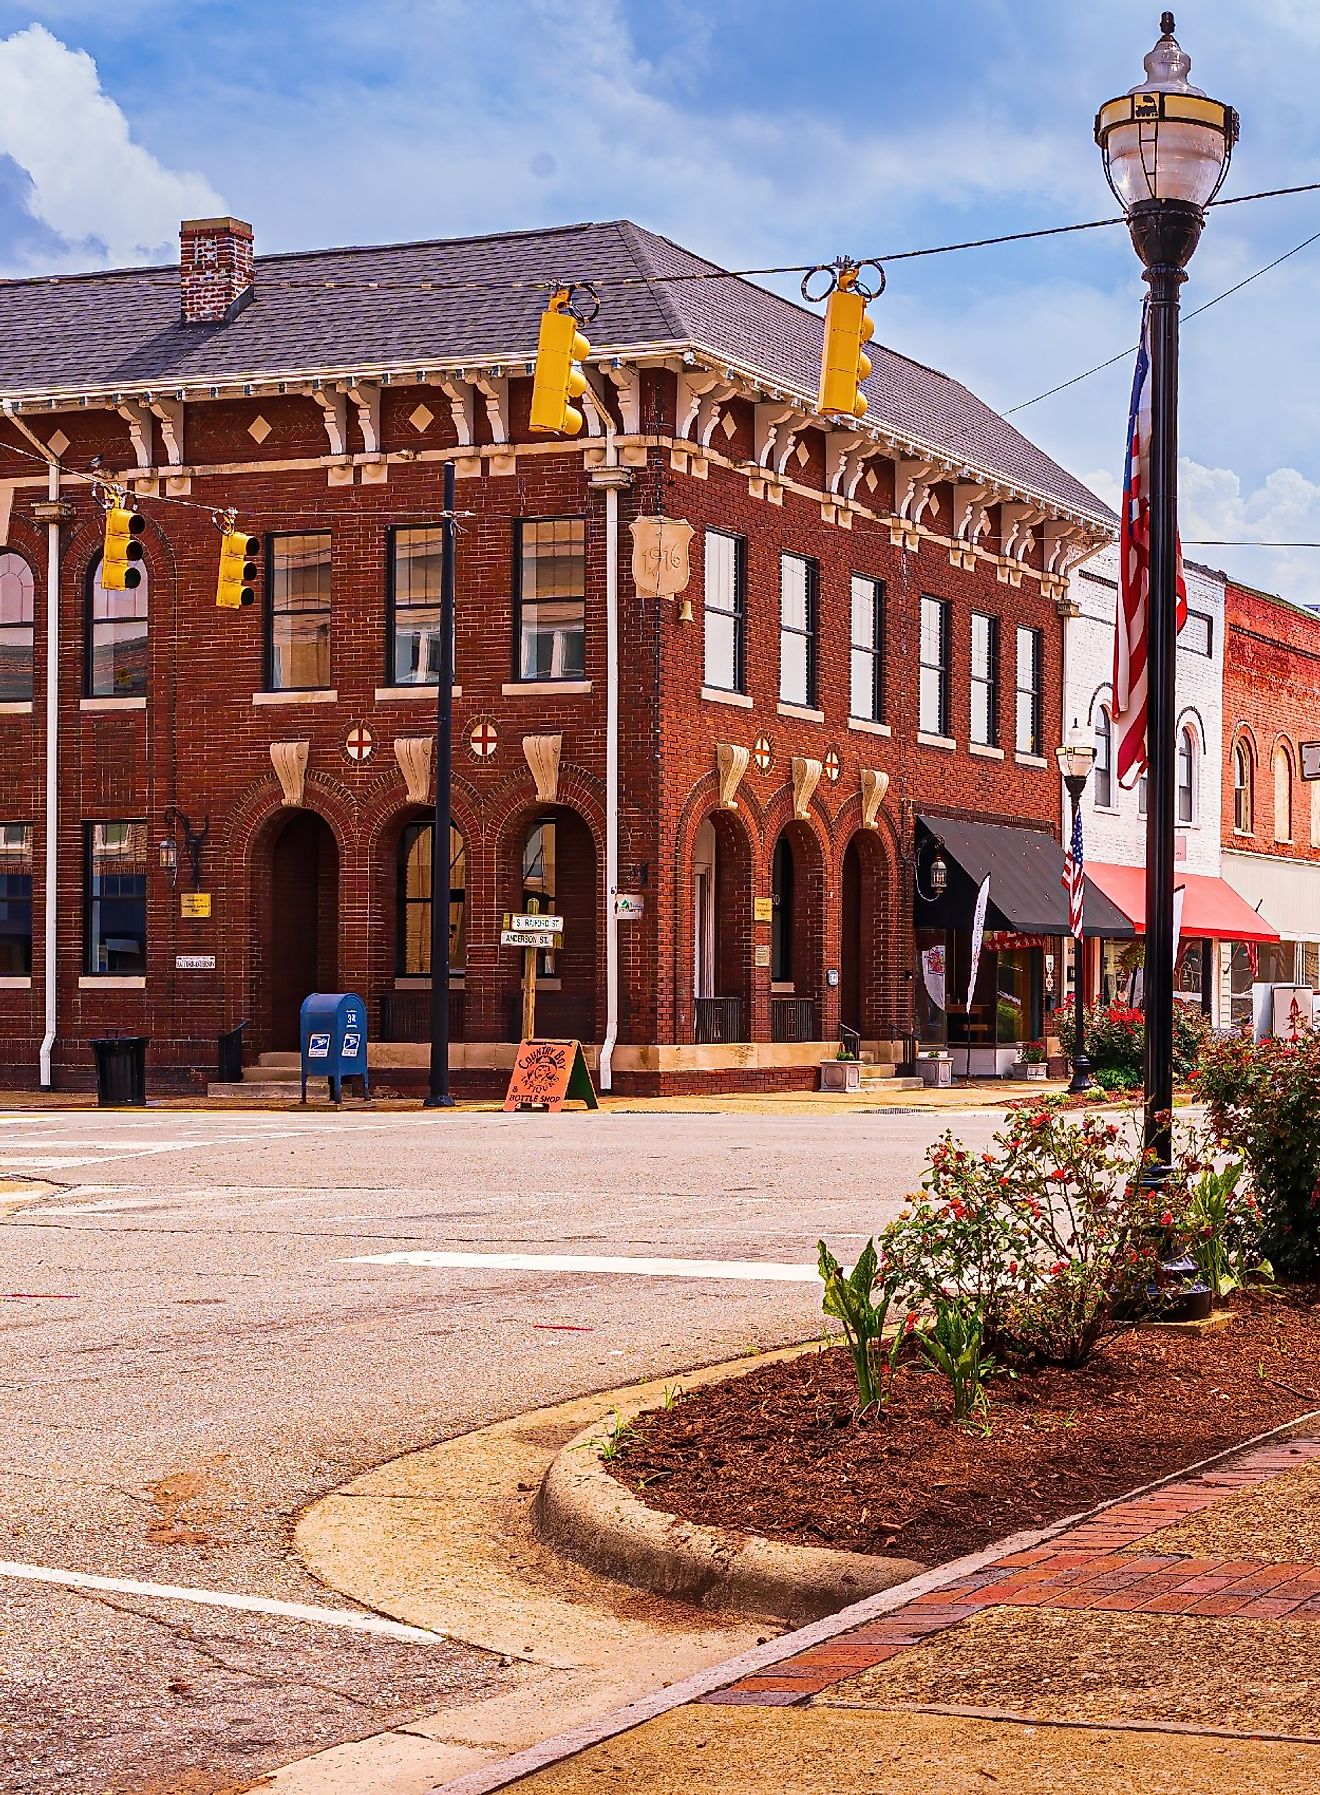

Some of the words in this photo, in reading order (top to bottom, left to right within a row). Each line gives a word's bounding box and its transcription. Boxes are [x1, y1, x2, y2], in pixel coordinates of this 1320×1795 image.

[642, 543, 681, 576] 1916
[524, 919, 550, 928] RAIFORD
[505, 934, 537, 944] ANDERSON
[518, 1046, 556, 1069] COUNTRY
[554, 1049, 566, 1070] BOY
[512, 1085, 519, 1093] &
[509, 1094, 539, 1103] BOTTLE
[539, 1095, 561, 1103] SHOP
